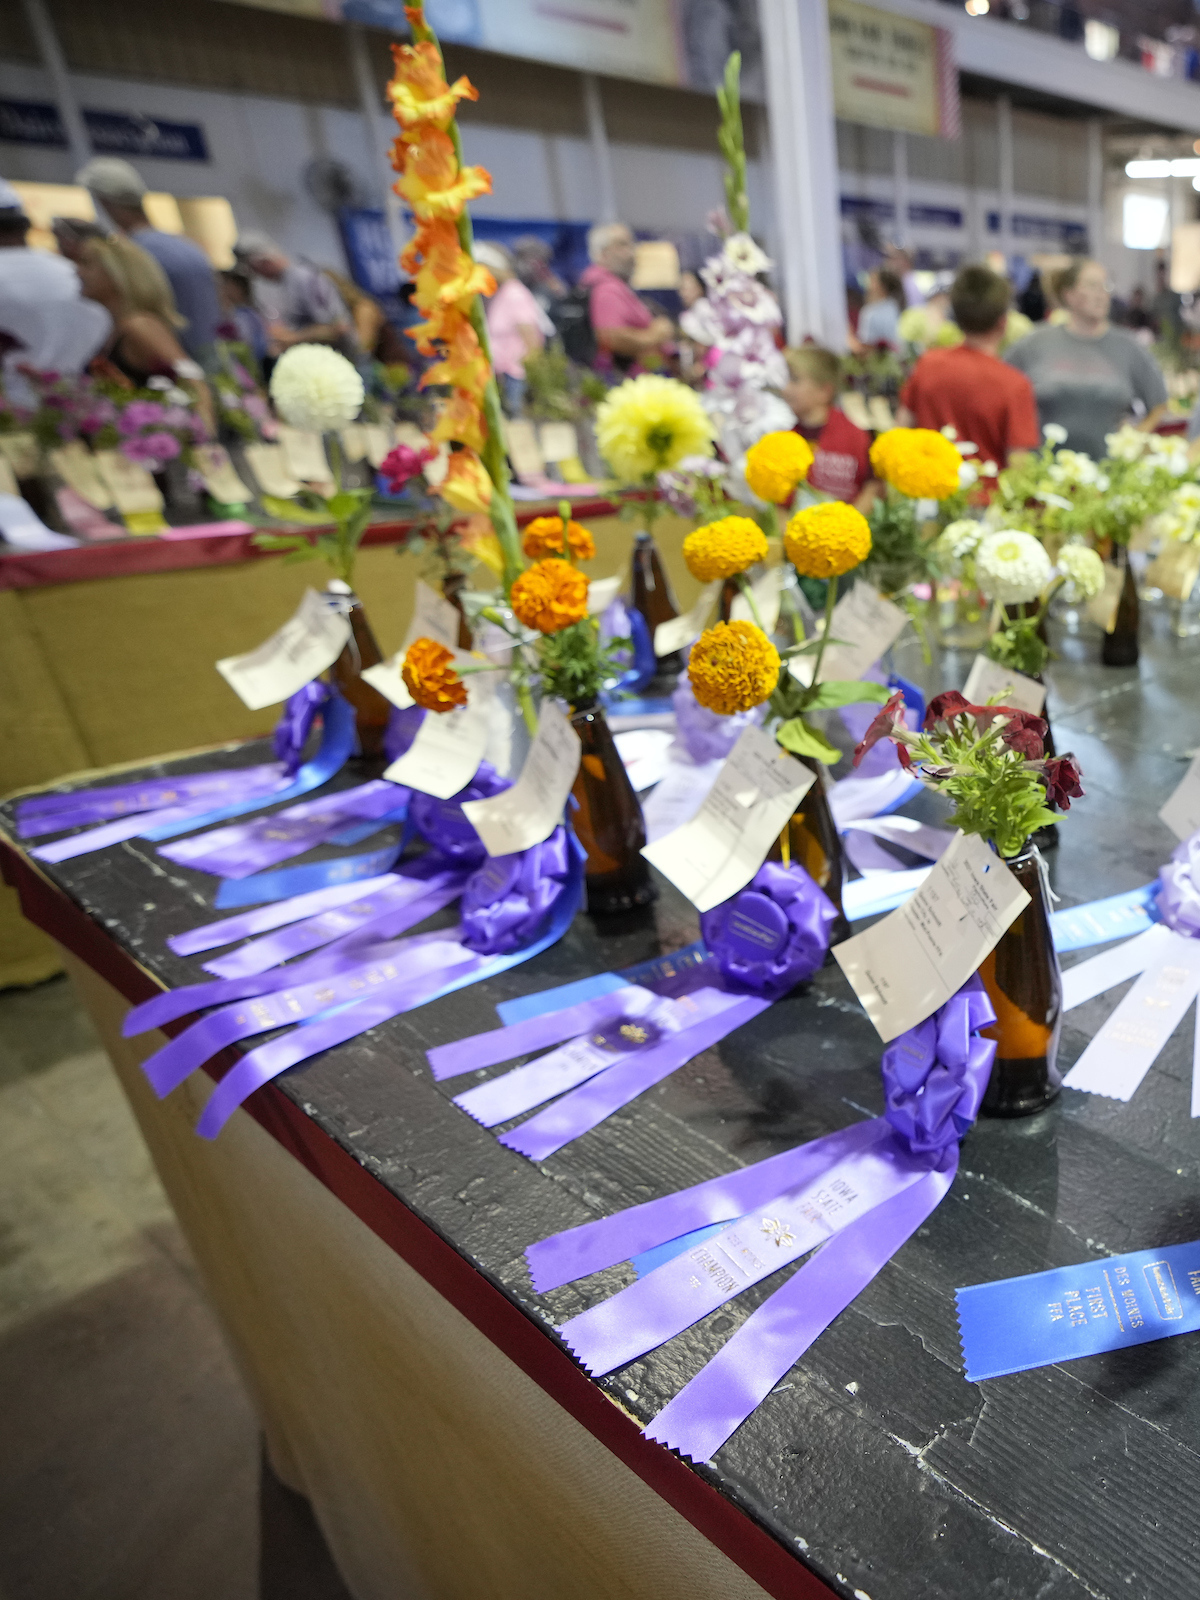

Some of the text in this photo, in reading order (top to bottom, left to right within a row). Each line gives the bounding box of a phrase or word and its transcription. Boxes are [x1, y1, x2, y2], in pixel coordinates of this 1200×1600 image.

[811, 1189, 844, 1217] STATE
[829, 1178, 859, 1204] IOWA
[796, 1202, 823, 1223] FAIR
[690, 1248, 740, 1294] CHAMPION
[1047, 1302, 1065, 1322] FFA
[1064, 1290, 1089, 1329] PLACE
[1085, 1286, 1109, 1320] FIRST
[1114, 1266, 1145, 1330] DES MOINES
